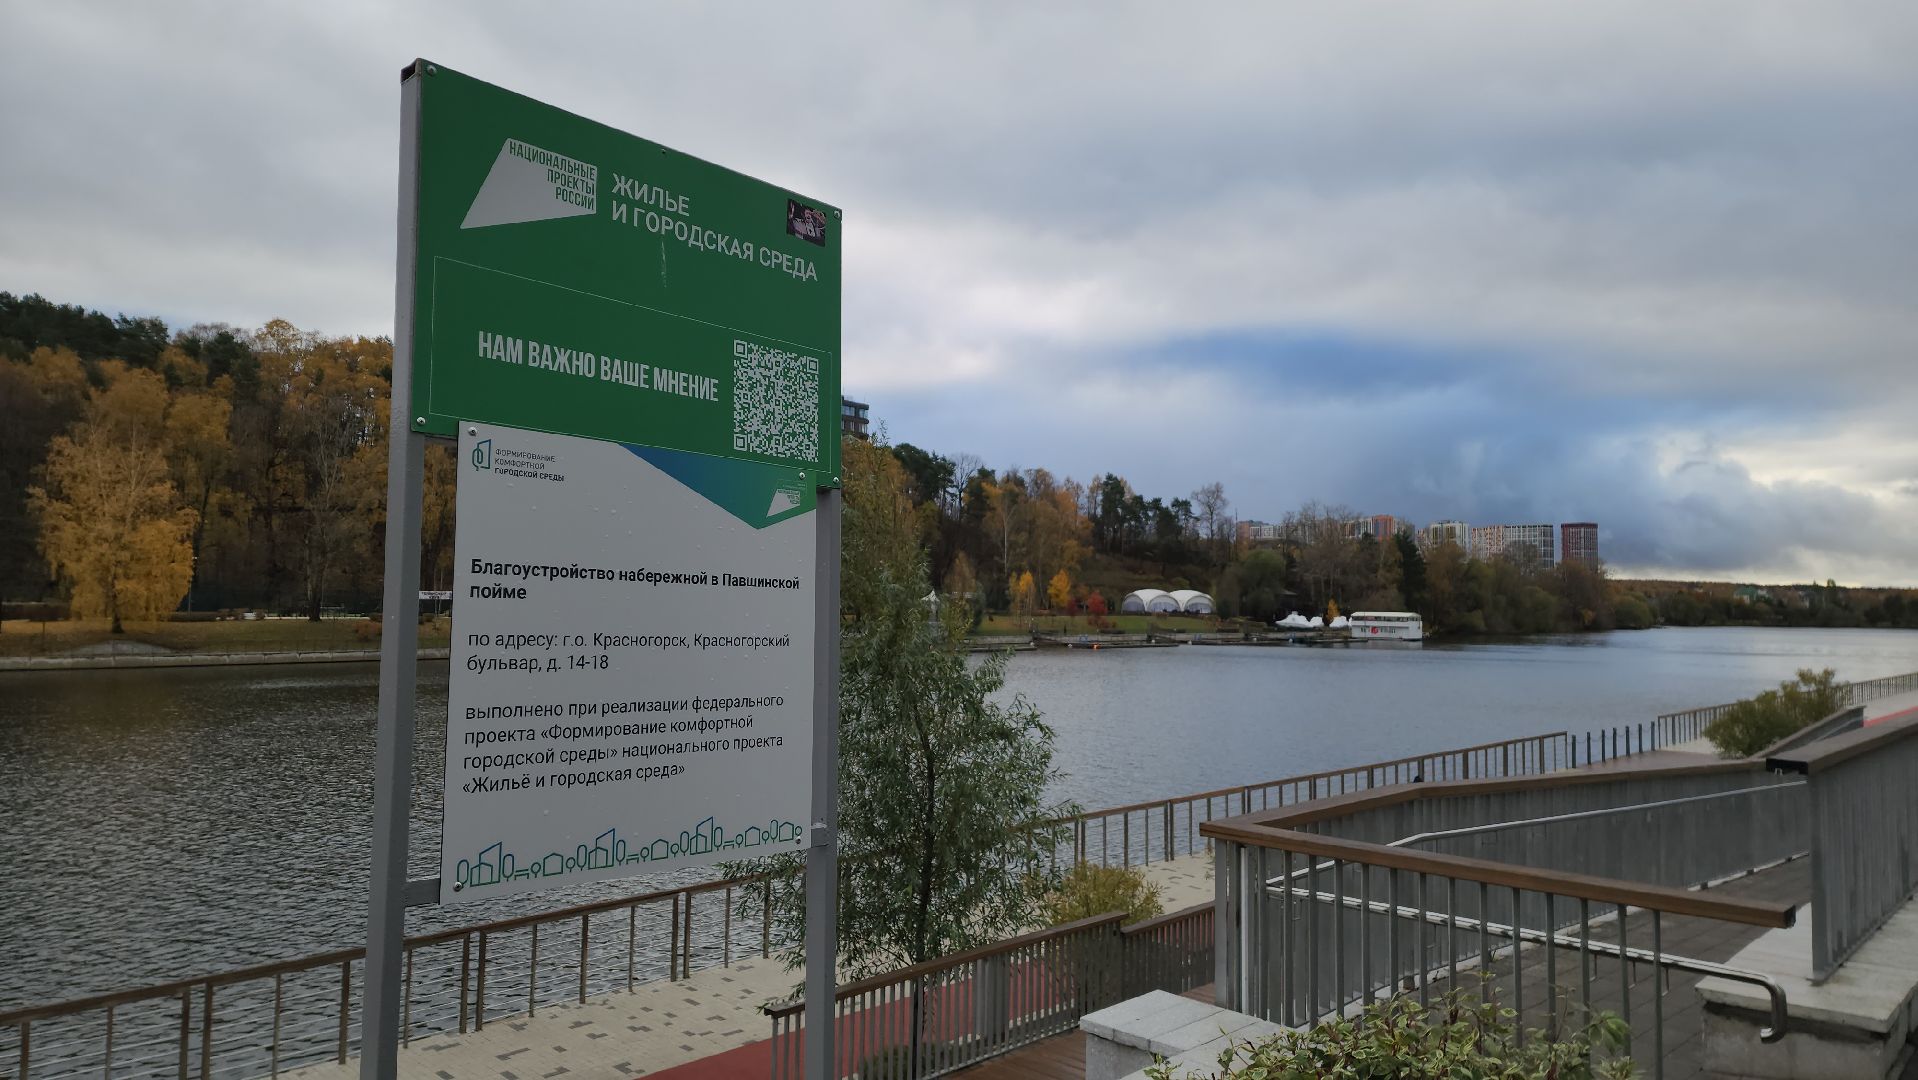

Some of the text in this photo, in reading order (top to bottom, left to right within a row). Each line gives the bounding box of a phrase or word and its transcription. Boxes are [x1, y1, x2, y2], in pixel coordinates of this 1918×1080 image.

[509, 141, 596, 181] НАЦИОНАЛЬНЫЕ
[547, 169, 596, 195] ПРОЕКТЫ
[611, 173, 690, 217] ЖИЛЬЕ
[555, 187, 595, 210] РОССИИ
[612, 200, 818, 282] И ГОРОДСКАЯ СРЕДА
[479, 330, 719, 402] НАМ ВАЖНО ВАШЕ МНЕНИЕ
[494, 458, 545, 470] КОМФОРТНОЙ
[495, 448, 556, 462] ФОРМИРОВАНИЕ
[494, 467, 565, 482] ГОРОДСКОЙ СРЕДЫ
[471, 558, 800, 590] Благоустройство набережной в Павшинской
[469, 583, 527, 599] пойме
[468, 632, 790, 651] по адресу: г.о. Красногорск, Красногорский
[467, 654, 609, 674] бульвар, д. 14-18
[465, 696, 784, 720] выполнено при реализации федерального
[464, 715, 753, 749] проекта «Формирование комфортной
[463, 736, 783, 773] городской среды» национального проекта
[462, 764, 685, 794] «Жильё и городская среда»
